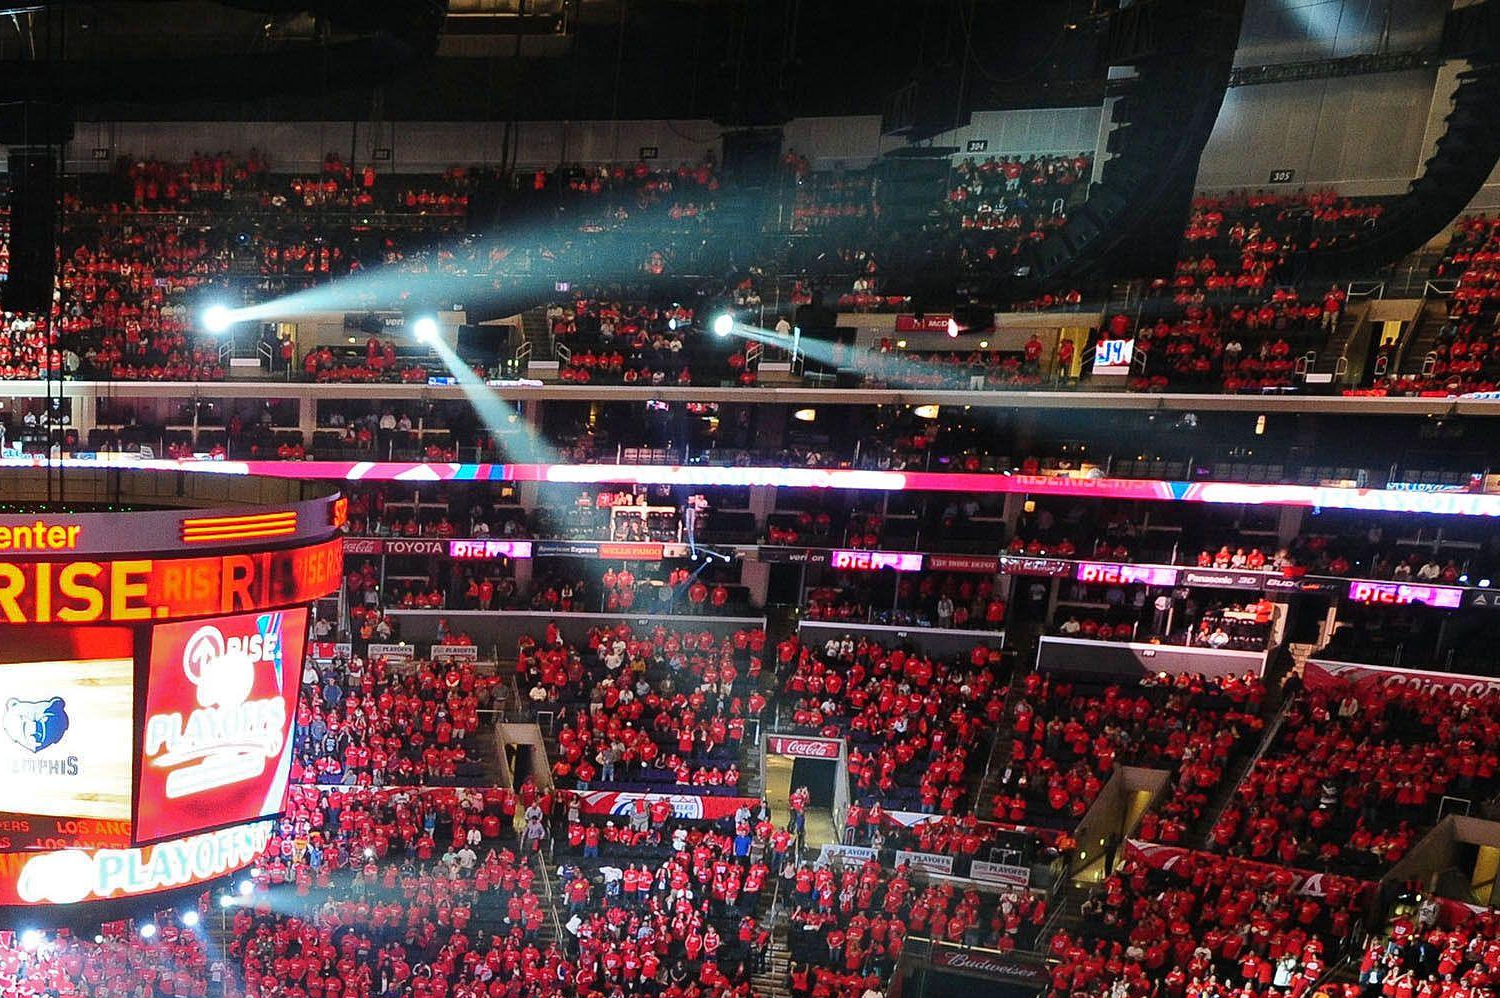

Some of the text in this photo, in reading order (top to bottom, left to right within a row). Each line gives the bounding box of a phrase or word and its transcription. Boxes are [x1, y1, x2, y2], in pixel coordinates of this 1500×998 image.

[970, 142, 986, 152] 304
[1273, 170, 1291, 182] 305
[386, 542, 443, 554] TOYOTA
[1187, 573, 1233, 585] Panasonic
[56, 821, 89, 835] LOS
[913, 854, 952, 867] PLAYOFFS
[989, 862, 1029, 877] PLAYOFFS
[943, 951, 1038, 978] Budweiser
